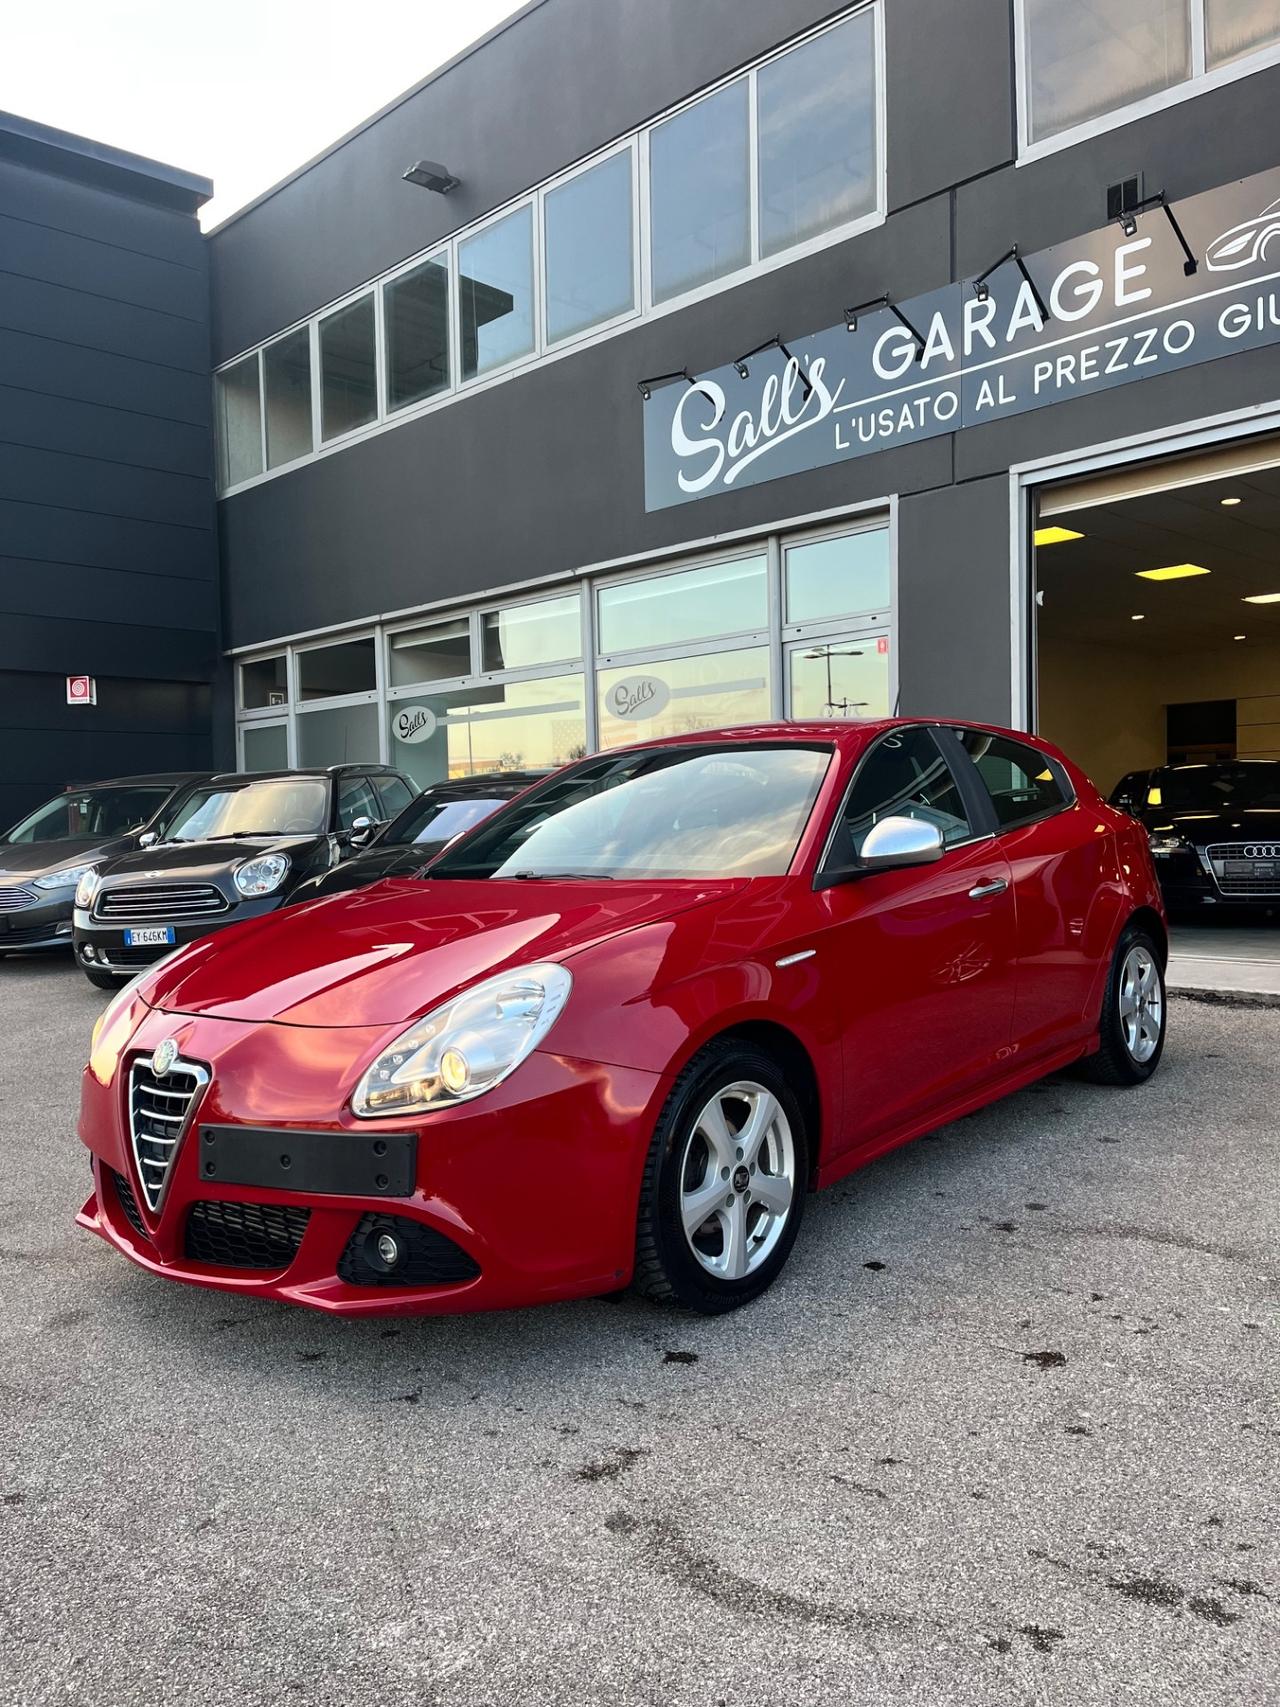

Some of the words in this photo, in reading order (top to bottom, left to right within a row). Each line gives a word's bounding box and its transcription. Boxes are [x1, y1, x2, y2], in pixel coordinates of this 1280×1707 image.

[672, 354, 846, 493] Sall's
[872, 237, 1152, 380] GARAGE
[835, 391, 958, 450] L'USATO
[975, 375, 1016, 411] AL
[1034, 320, 1195, 394] PREZZO
